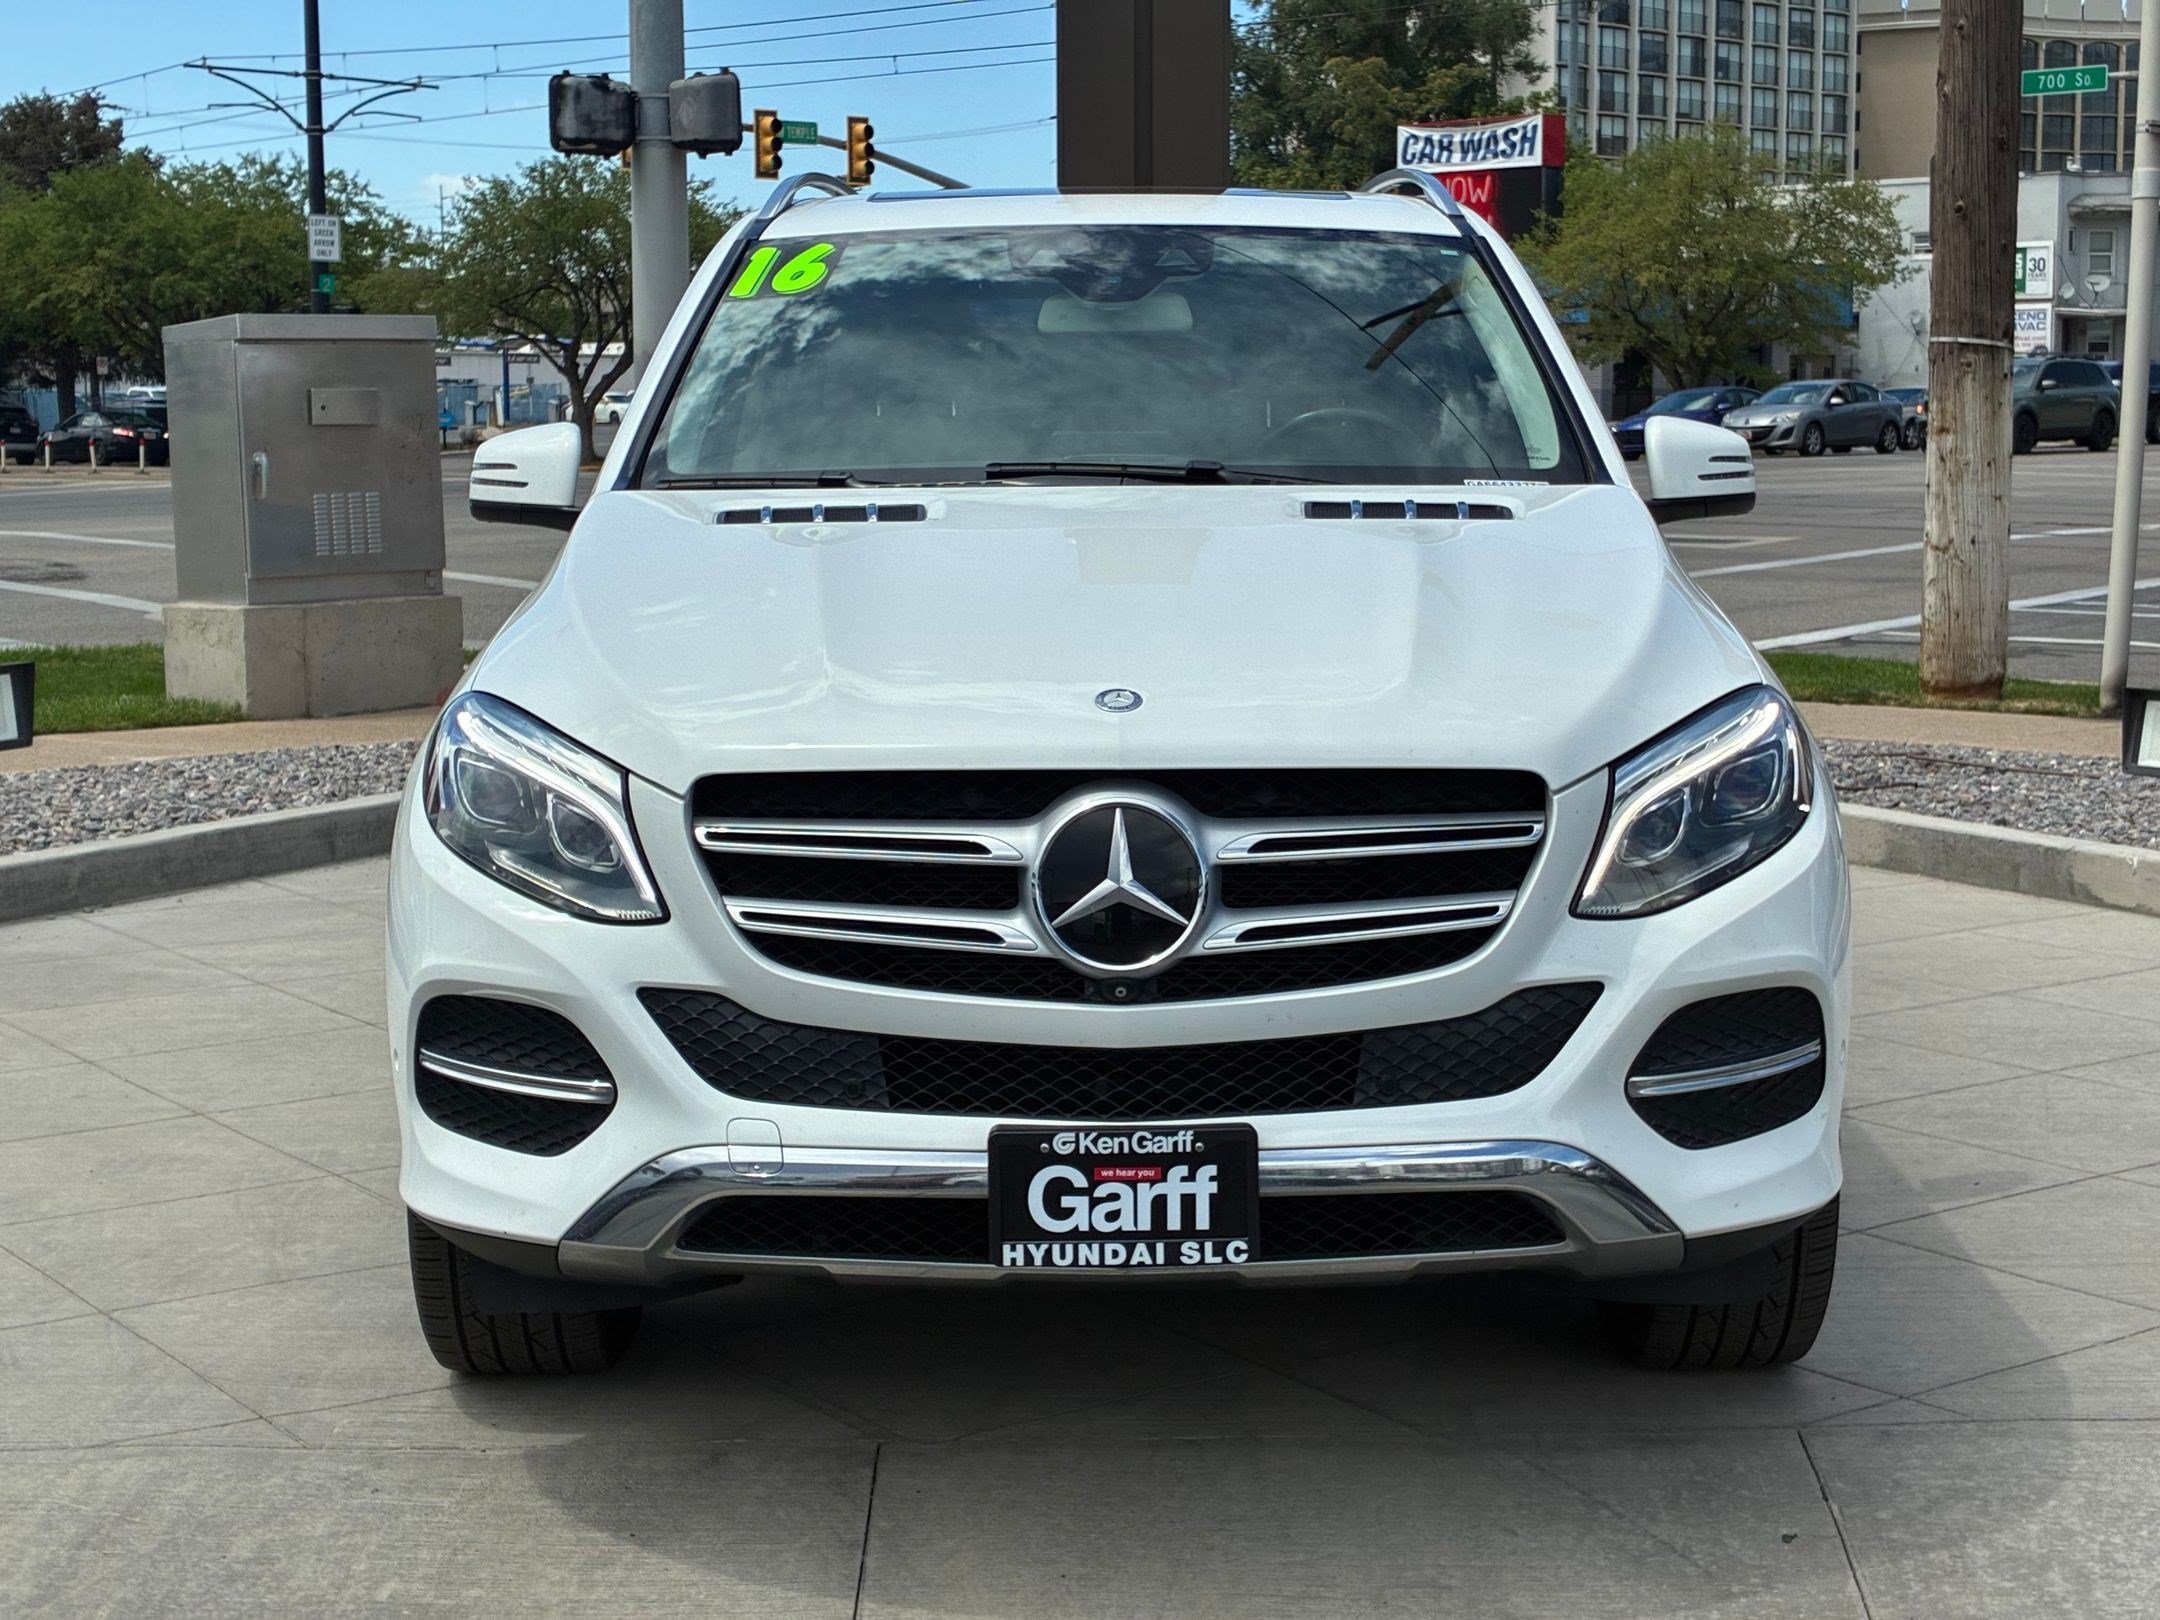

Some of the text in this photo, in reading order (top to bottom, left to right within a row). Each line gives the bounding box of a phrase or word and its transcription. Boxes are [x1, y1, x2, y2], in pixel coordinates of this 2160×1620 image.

[2037, 73, 2066, 90] 700
[787, 126, 816, 140] TEMPLE
[1401, 123, 1539, 166] CAR WASH
[1444, 174, 1493, 204] OW
[311, 218, 337, 227] LEFT ON
[314, 228, 334, 237] GREEN
[313, 239, 335, 247] ARROW
[316, 249, 332, 257] ONLY
[728, 242, 837, 298] 16
[2028, 257, 2047, 273] 30
[321, 277, 331, 292] 2
[2014, 311, 2047, 321] ENO
[2014, 321, 2047, 331] VAC
[1101, 1167, 1156, 1179] we hear you
[1027, 1164, 1218, 1233] Garff
[1002, 1240, 1249, 1266] HYUNDAI SLC
